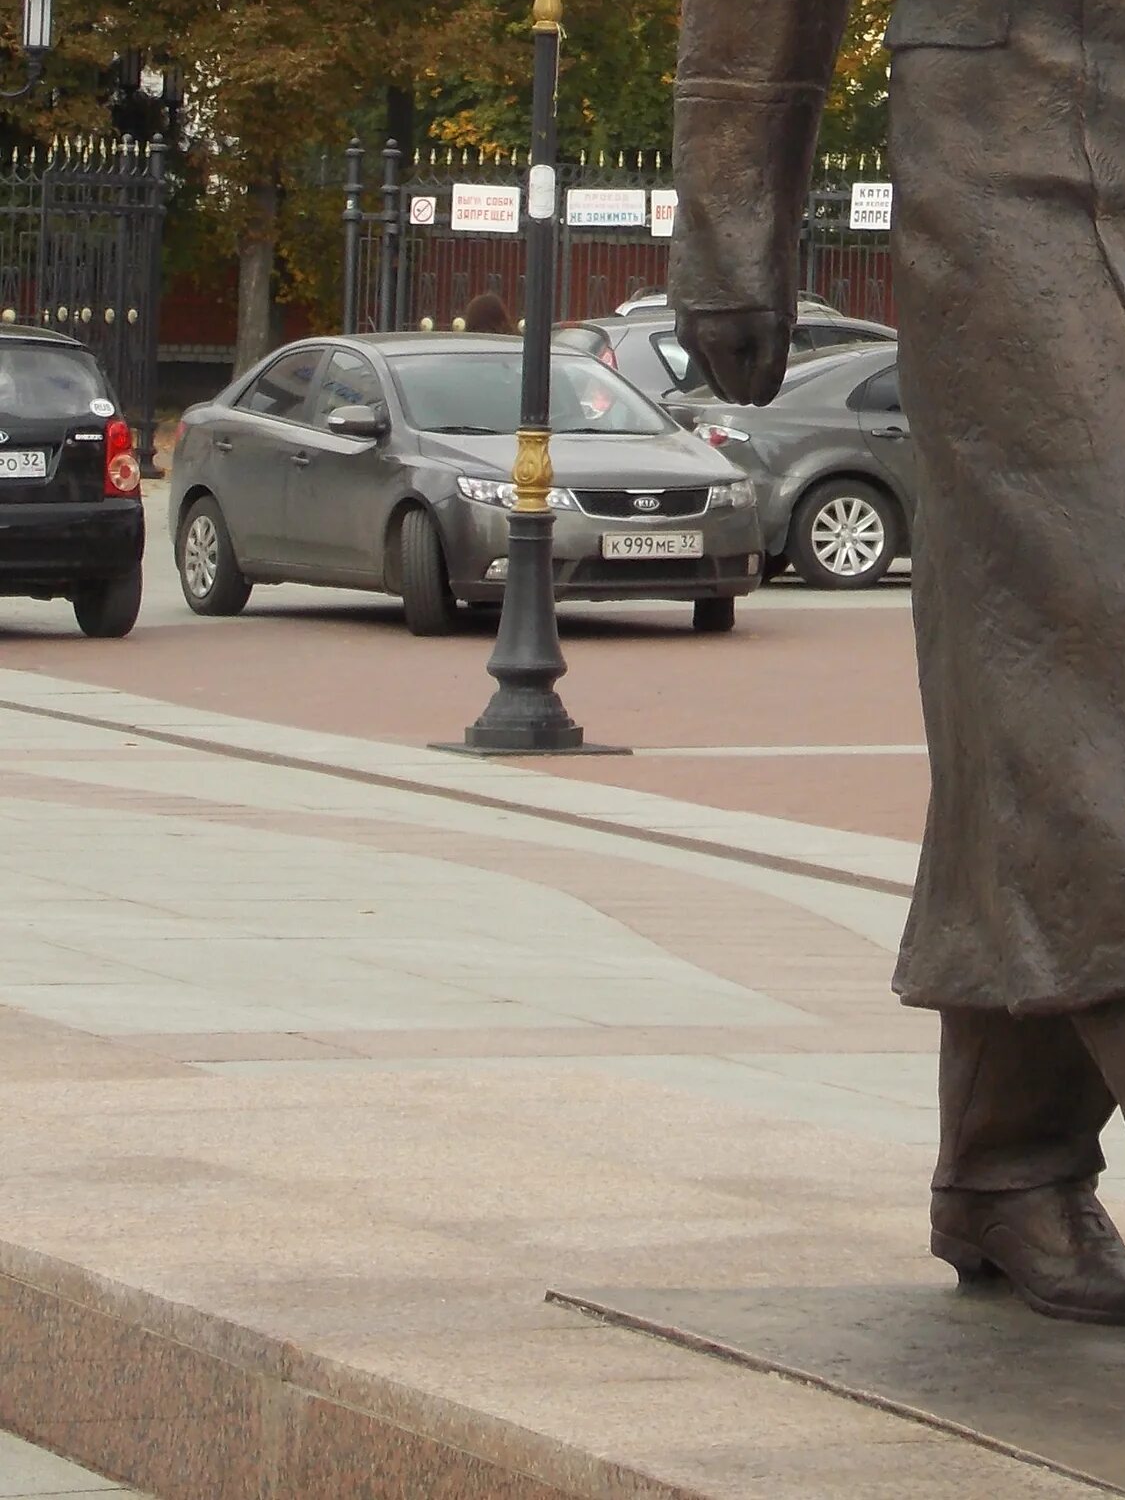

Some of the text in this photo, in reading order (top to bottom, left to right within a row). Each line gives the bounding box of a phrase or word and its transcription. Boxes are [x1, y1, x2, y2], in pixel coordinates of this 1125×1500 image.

[486, 196, 514, 206] СОБАК
[457, 208, 514, 221] ЗАПРЕЩЕН
[570, 212, 582, 223] НЕ
[22, 453, 40, 466] 32
[638, 499, 656, 508] KIA
[681, 535, 696, 548] 32
